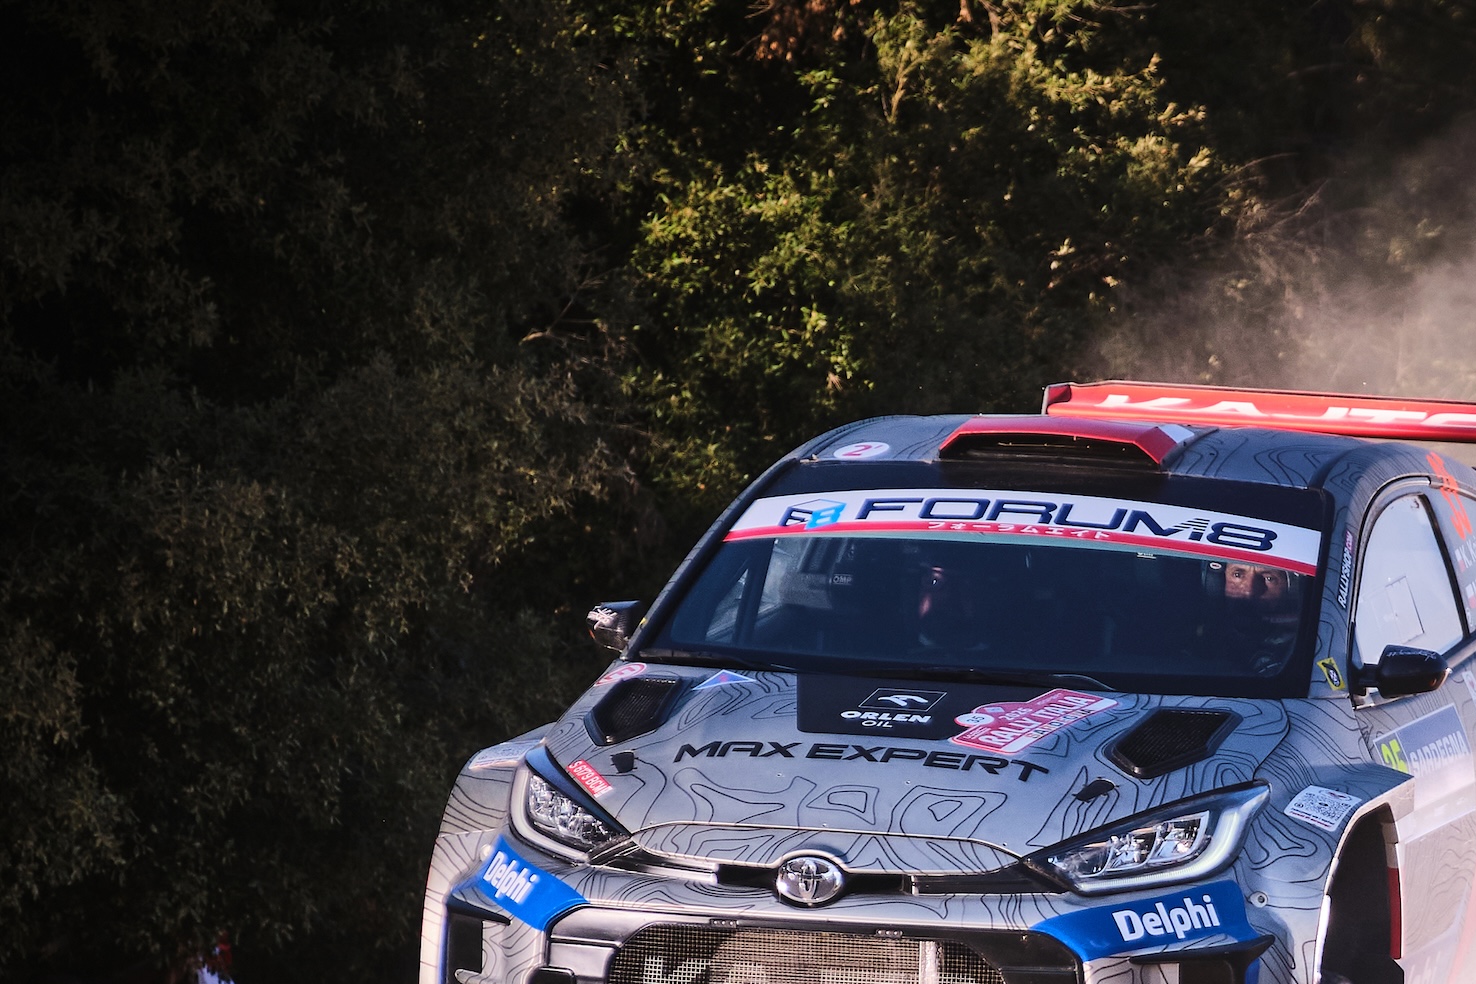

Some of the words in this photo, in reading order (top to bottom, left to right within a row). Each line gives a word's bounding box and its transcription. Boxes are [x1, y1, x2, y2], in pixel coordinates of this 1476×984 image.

[855, 497, 1278, 551] FORUM8
[840, 710, 932, 723] ORLEN
[861, 720, 893, 728] OIL
[978, 716, 1042, 746] RALLY
[1031, 696, 1096, 720] ITALIA
[673, 740, 803, 764] MAX
[804, 743, 1050, 782] EXPERT
[1409, 730, 1470, 778] SARDEGNA
[482, 849, 541, 906] Delphi
[1111, 894, 1221, 942] Delphi
